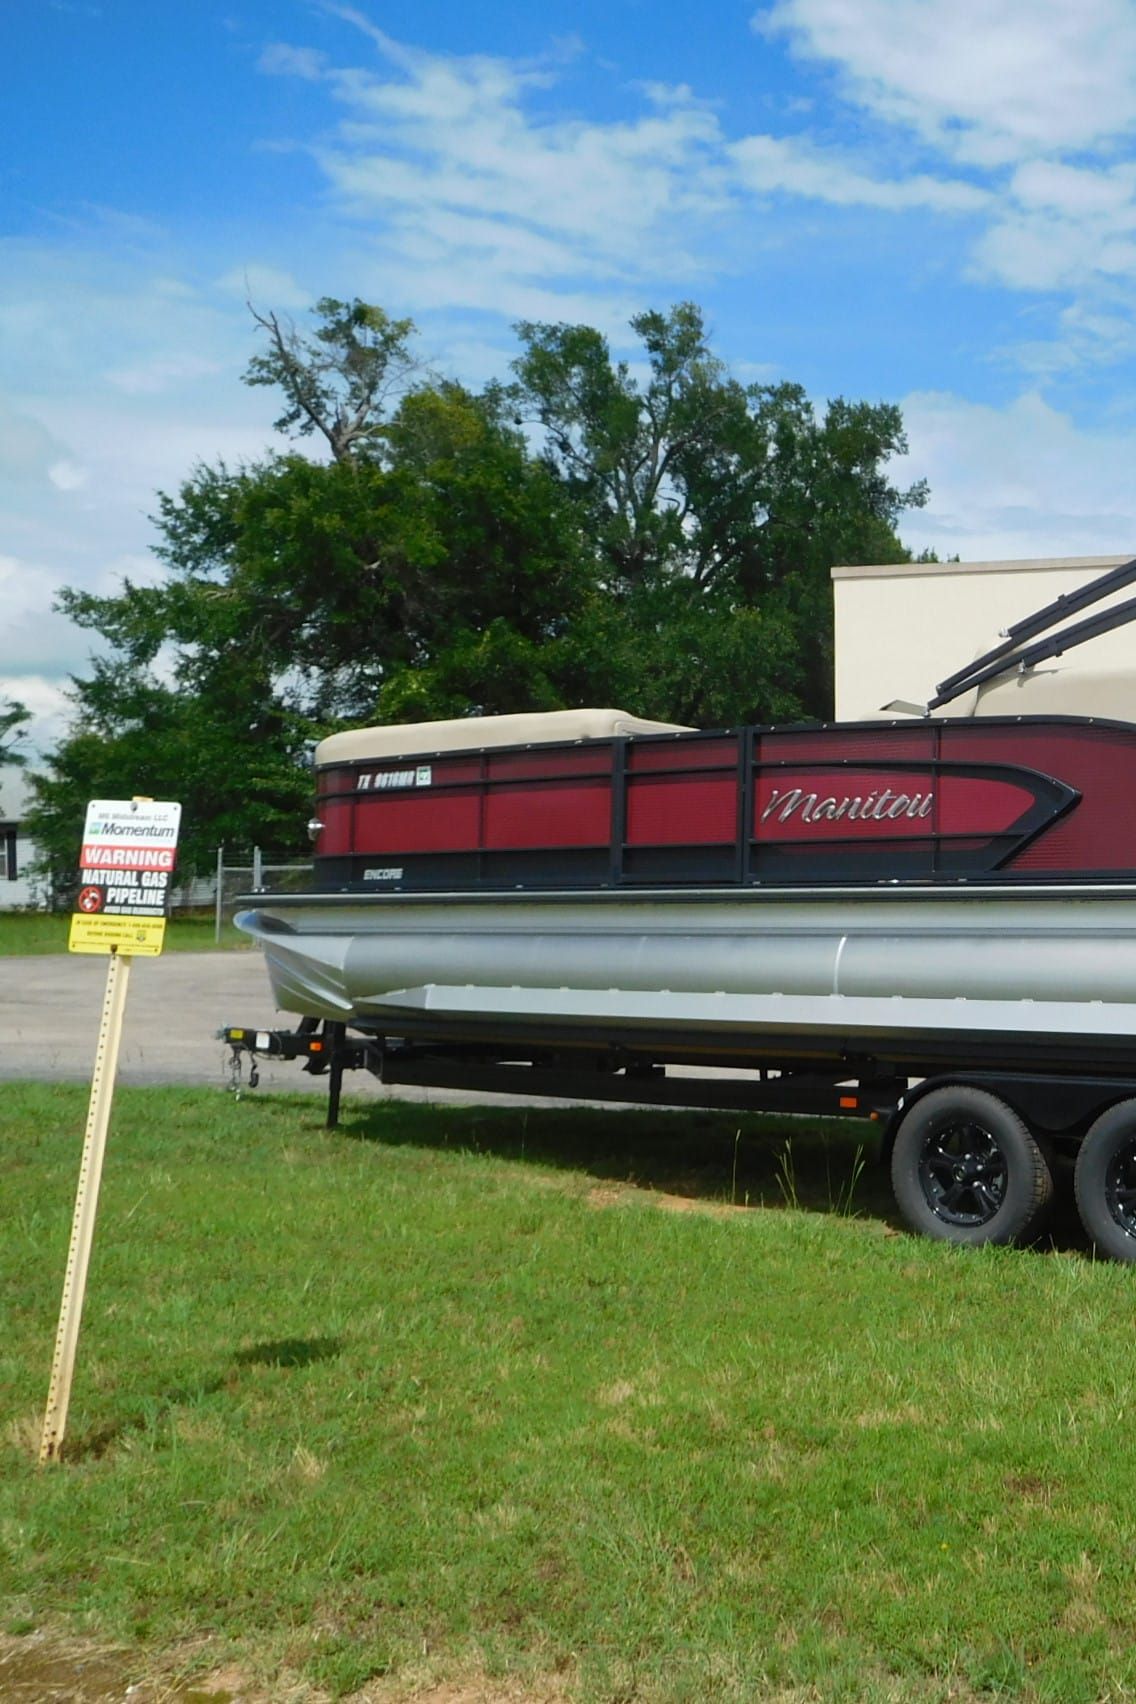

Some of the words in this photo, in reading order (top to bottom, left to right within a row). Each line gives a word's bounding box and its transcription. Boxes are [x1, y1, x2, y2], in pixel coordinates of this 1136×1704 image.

[761, 788, 933, 823] Manitou
[101, 822, 175, 838] Momentum
[85, 848, 171, 867] WARNING
[82, 869, 139, 886] NATURAL
[141, 871, 168, 888] GAS
[363, 868, 403, 880] ENCORE
[106, 887, 165, 905] PIPELINE
